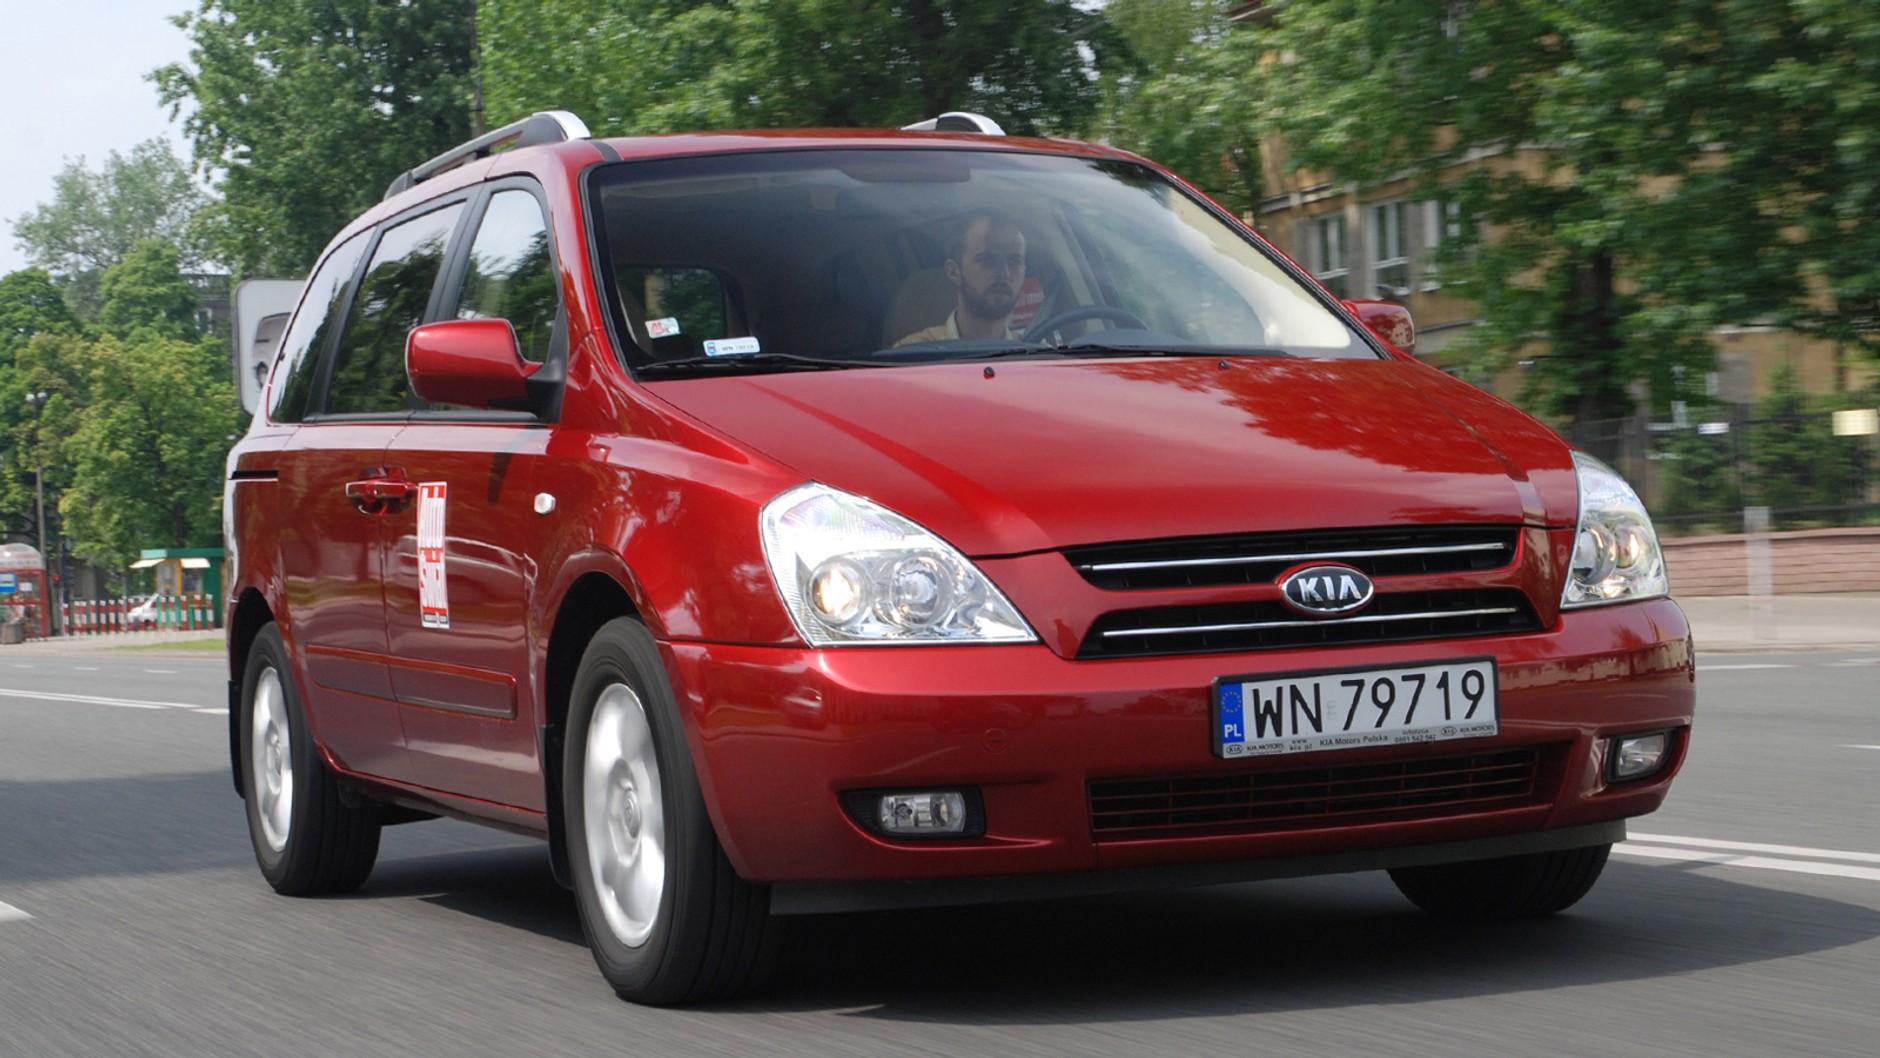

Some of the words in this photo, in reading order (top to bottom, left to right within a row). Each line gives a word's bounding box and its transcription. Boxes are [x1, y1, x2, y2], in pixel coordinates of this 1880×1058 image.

[1297, 575, 1361, 602] KIA
[1252, 683, 1323, 739] WN
[1341, 669, 1485, 732] 79719
[1224, 723, 1242, 739] PL
[1335, 737, 1361, 746] Motors
